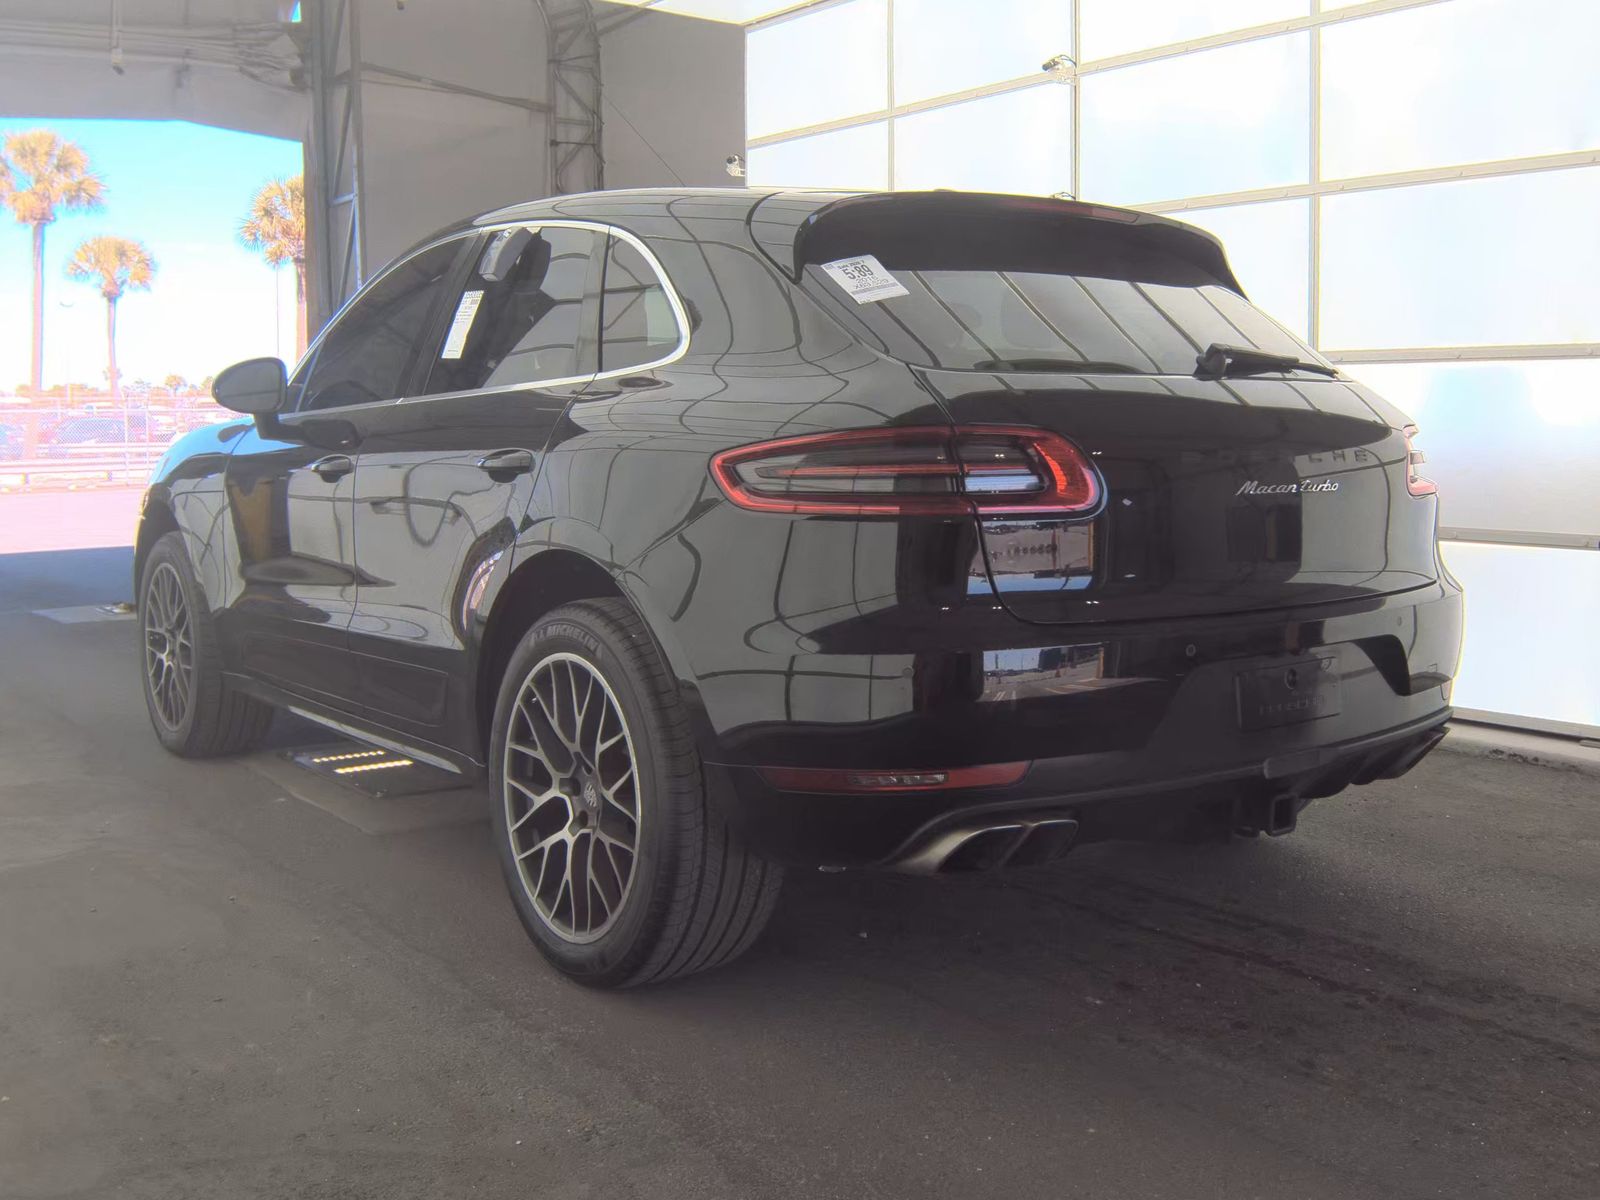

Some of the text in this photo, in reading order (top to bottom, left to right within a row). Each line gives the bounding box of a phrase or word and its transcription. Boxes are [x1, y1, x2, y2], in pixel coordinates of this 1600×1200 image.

[841, 264, 874, 280] 5:89
[1235, 480, 1298, 496] Macan
[546, 624, 599, 653] MICHELIN
